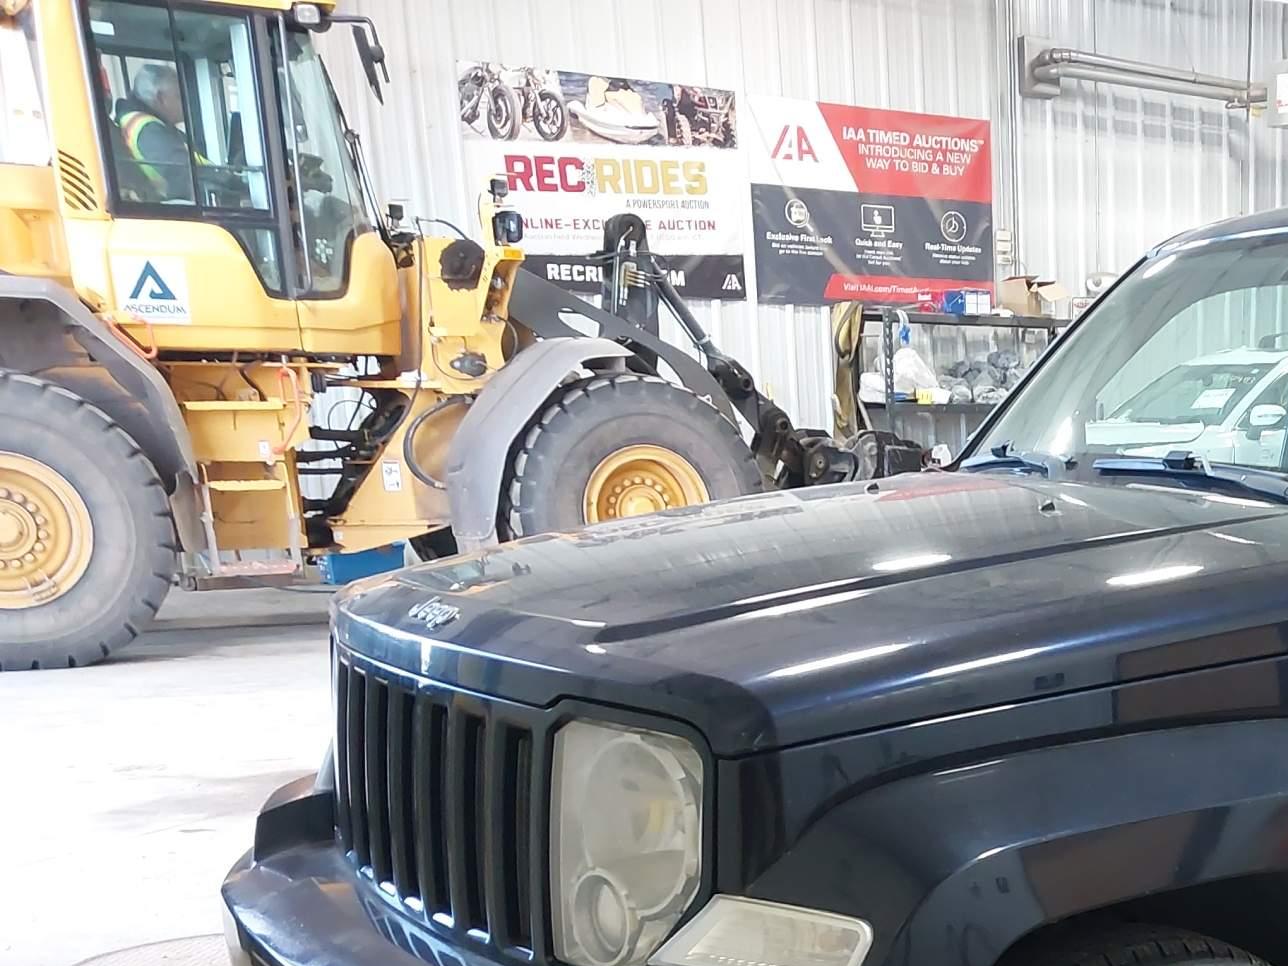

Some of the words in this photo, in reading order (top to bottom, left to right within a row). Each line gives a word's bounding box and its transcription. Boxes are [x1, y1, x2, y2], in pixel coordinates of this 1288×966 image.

[842, 126, 865, 141] IAA
[867, 129, 910, 146] TIMED
[858, 143, 933, 161] INTRODUCING
[936, 151, 944, 162] A
[946, 152, 972, 164] NEW
[866, 157, 891, 170] WAY
[893, 159, 909, 171] TO
[912, 161, 929, 174] BID
[931, 163, 940, 175] &
[942, 165, 966, 177] BUY
[632, 199, 679, 209] POWERSPORT
[680, 200, 710, 210] AUCTION
[658, 220, 716, 231] AUCTION
[887, 239, 903, 250] Easy
[124, 303, 187, 314] ASCENDUM
